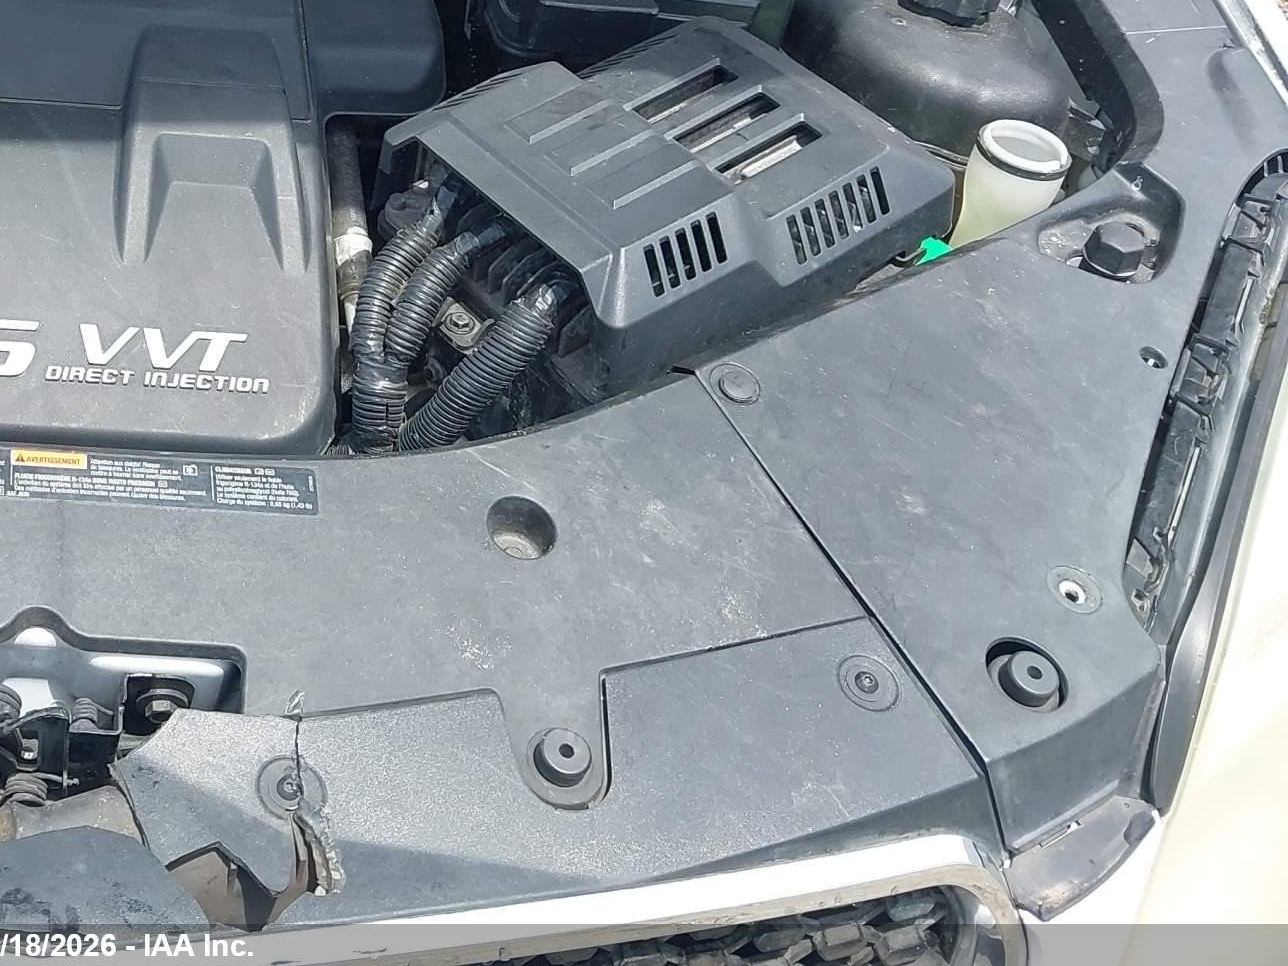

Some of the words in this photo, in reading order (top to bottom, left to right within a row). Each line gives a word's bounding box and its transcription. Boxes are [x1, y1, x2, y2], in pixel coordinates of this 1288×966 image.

[80, 324, 248, 372] VVT
[45, 364, 135, 386] DIRECT
[144, 372, 270, 395] INJECTION
[27, 456, 80, 465] AVERTISSEMENT
